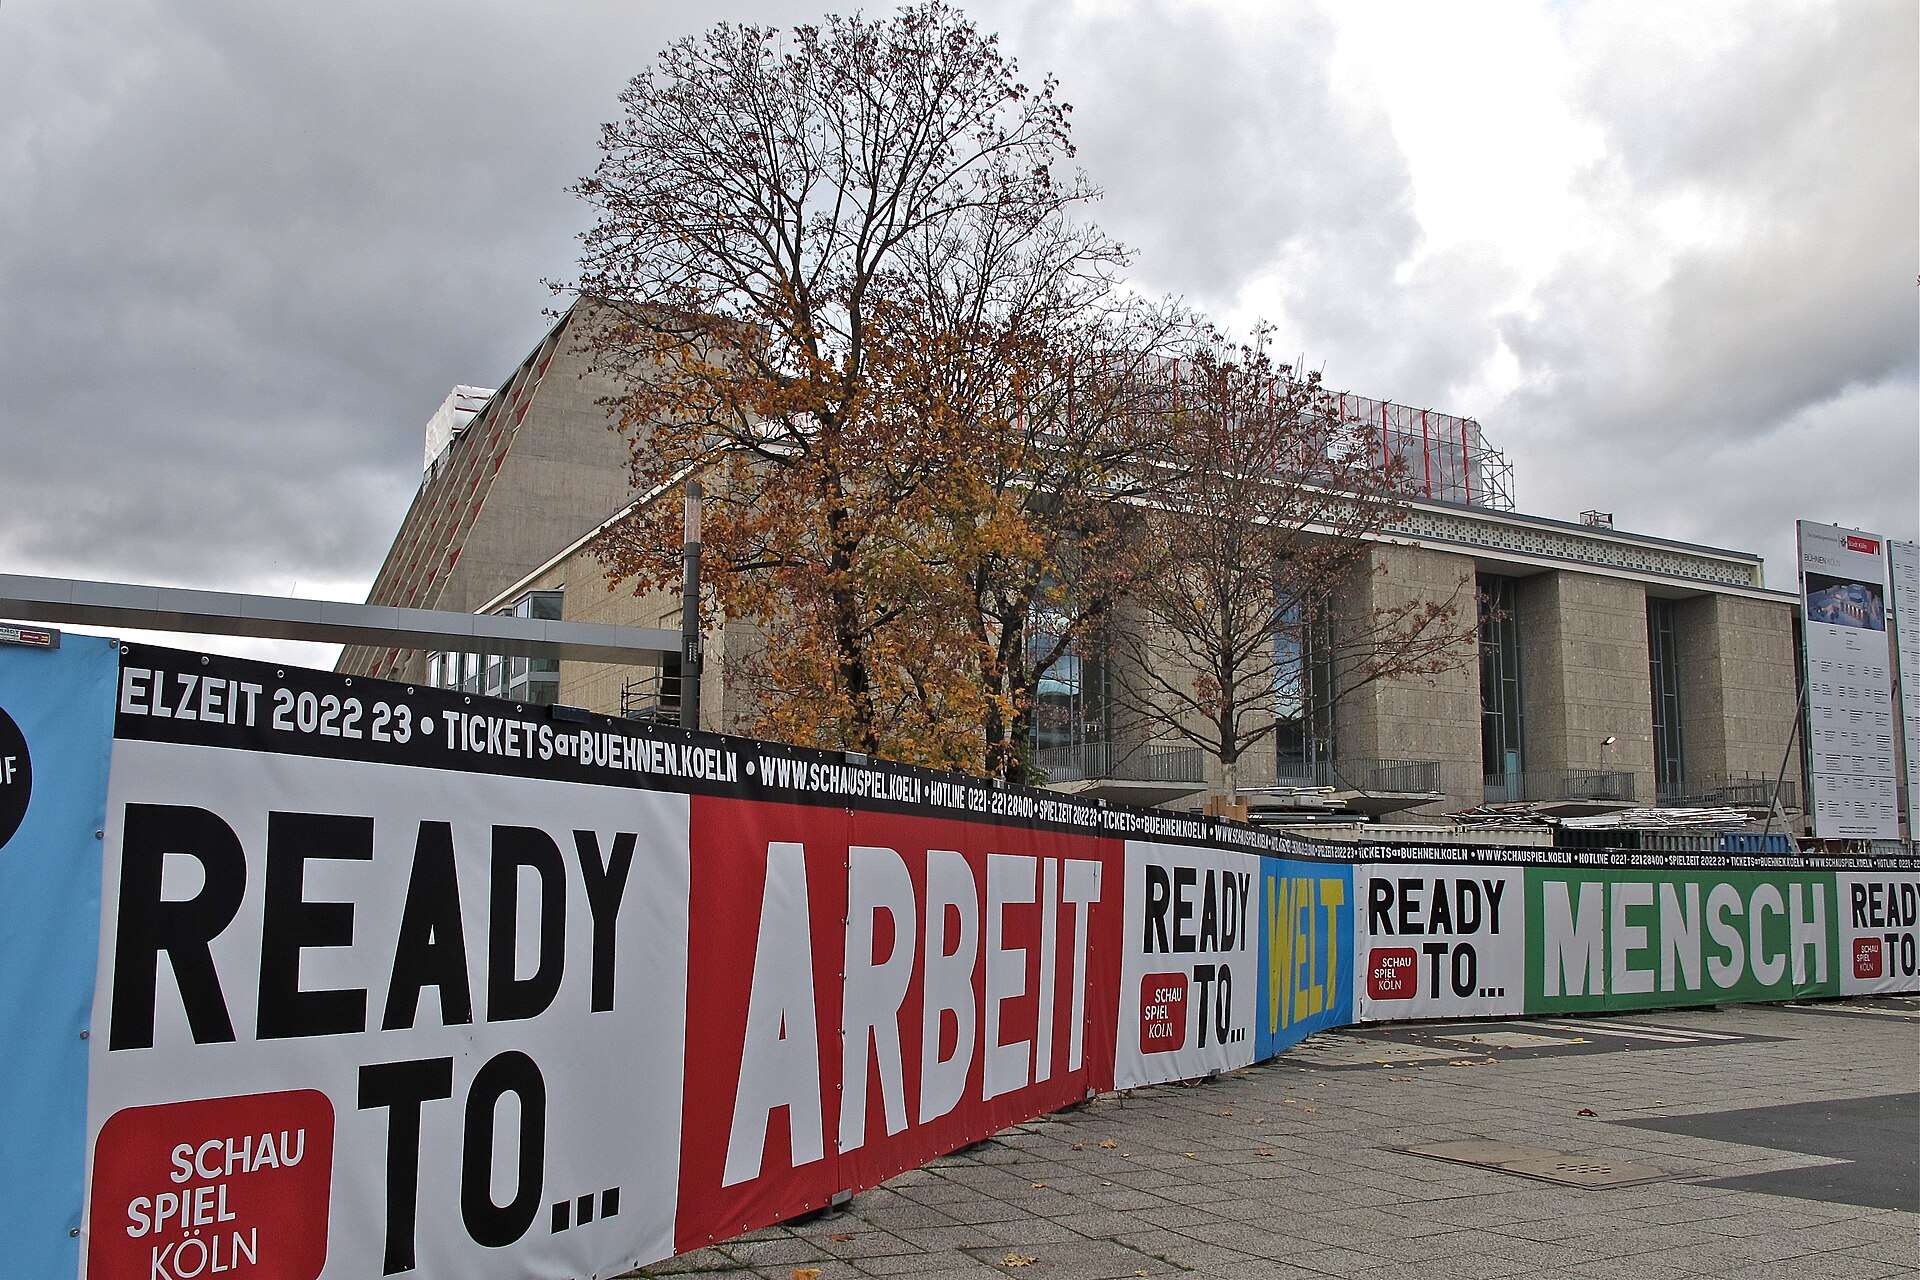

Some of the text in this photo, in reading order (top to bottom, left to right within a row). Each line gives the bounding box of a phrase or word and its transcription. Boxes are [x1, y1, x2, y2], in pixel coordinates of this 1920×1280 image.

[0, 756, 16, 784] F
[120, 667, 262, 727] ELZEIT
[273, 687, 363, 740] 2022
[371, 701, 412, 744] 23
[759, 755, 921, 804] WWW.SCHAUSPIEL.KOELN
[930, 780, 965, 810] HOTLINE
[1039, 800, 1072, 824] SPIELZEIT
[1073, 805, 1089, 826] 2022
[1089, 807, 1097, 827] 23
[1347, 846, 1355, 859] 23
[1579, 853, 1608, 865] HOTLINE
[1668, 855, 1699, 867] SPIELZEIT
[1701, 855, 1716, 867] 2022
[1717, 856, 1726, 867] 23
[110, 803, 638, 1051] READY
[1143, 864, 1250, 954] READY
[1368, 877, 1506, 936] READY
[1268, 876, 1345, 1035] WELT
[1382, 957, 1412, 968] SCHAU
[1543, 880, 1828, 998] MENSCH
[1856, 954, 1871, 962] SPIEL
[1860, 945, 1879, 954] SCHAU
[1374, 968, 1397, 979] SPIEL
[1378, 978, 1402, 991] KÖLN
[1422, 942, 1505, 999] TO...
[1860, 961, 1874, 972] KÖLN
[721, 841, 1103, 1188] ARBEIT
[1144, 1004, 1168, 1021] SPIEL
[1154, 987, 1182, 1004] SCHAU
[1193, 963, 1246, 1049] TO...
[1148, 1020, 1173, 1039] KÖLN
[170, 1128, 305, 1184] SCHAU
[357, 1049, 621, 1277] TO...
[126, 1184, 236, 1238] SPIEL
[150, 1227, 257, 1280] KÖLN
